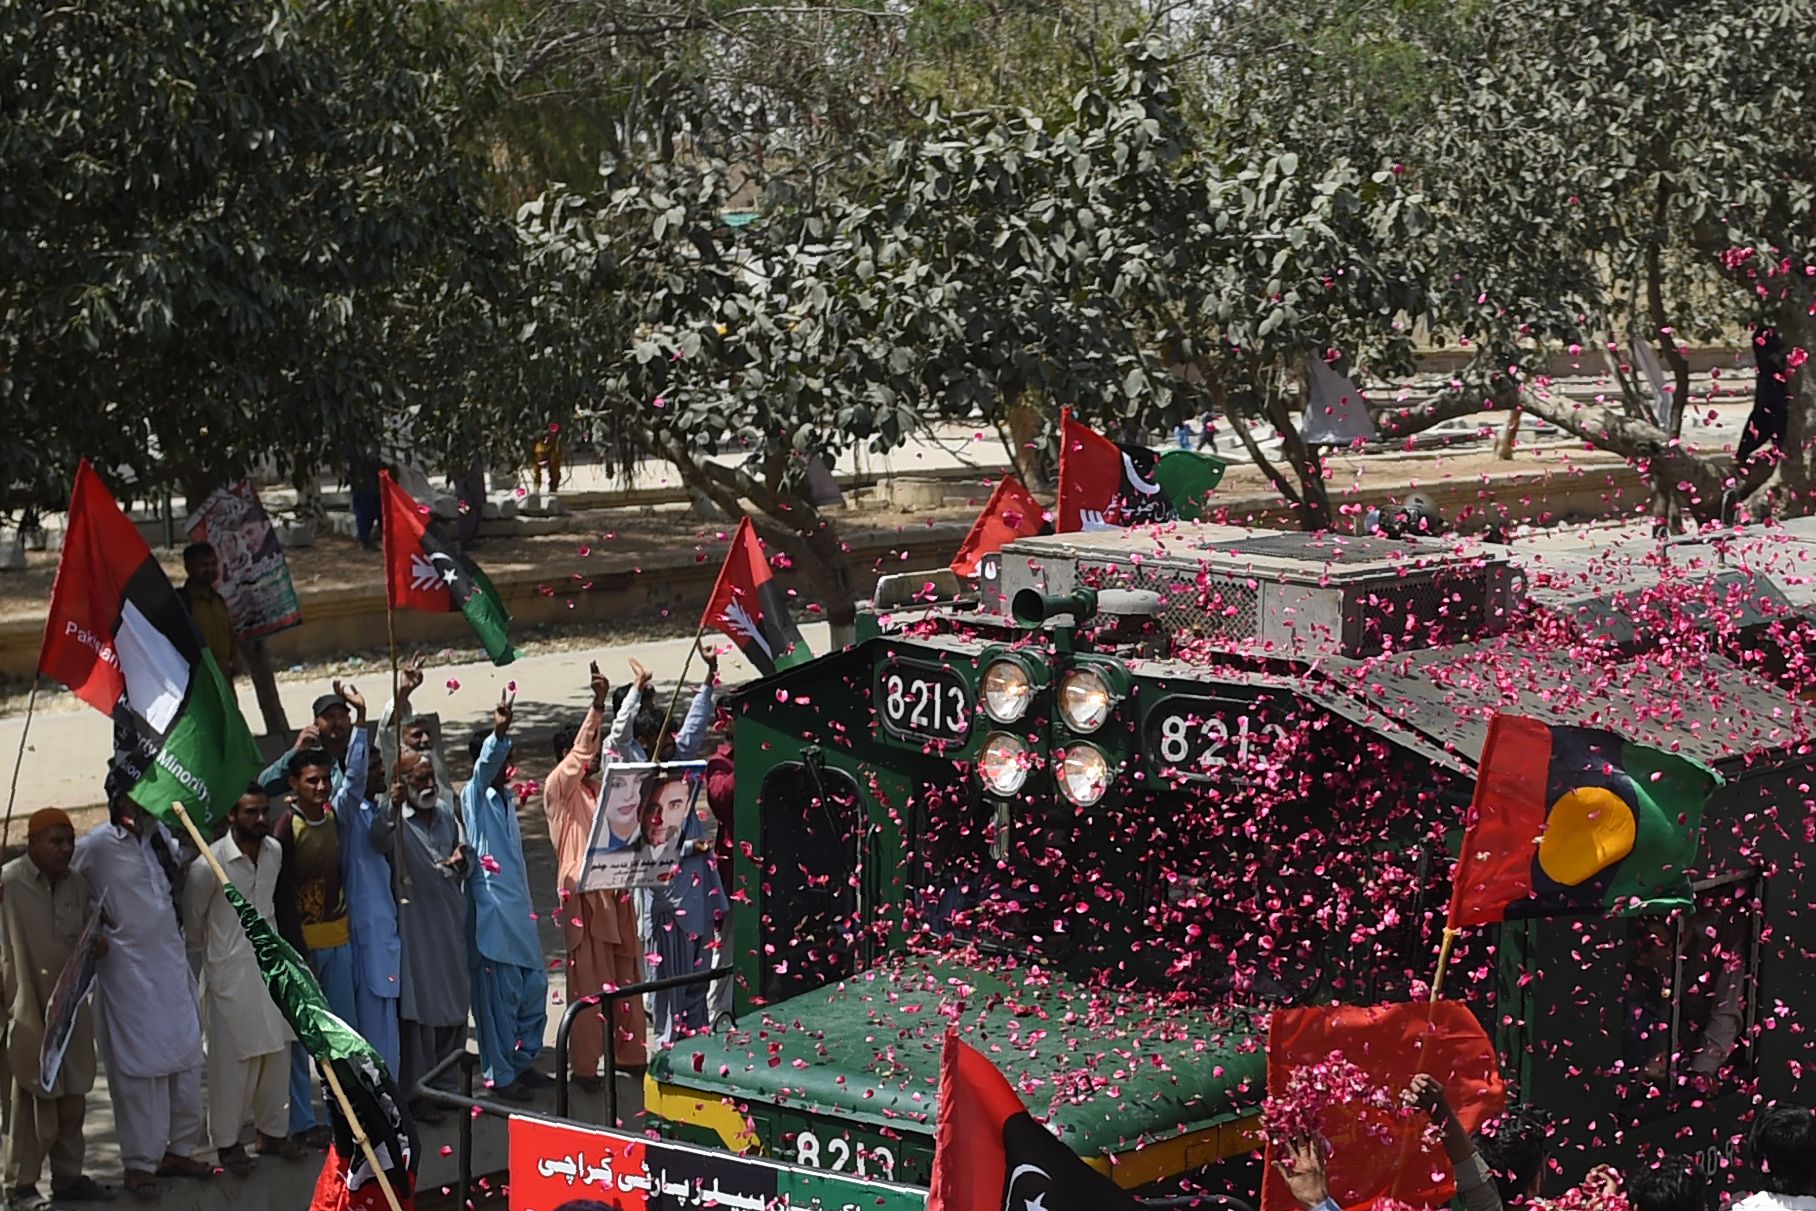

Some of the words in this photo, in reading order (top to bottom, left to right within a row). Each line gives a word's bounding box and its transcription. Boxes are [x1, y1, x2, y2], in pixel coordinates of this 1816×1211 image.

[887, 673, 966, 732] 8213
[156, 748, 210, 801] Minority
[537, 1150, 614, 1186] کراچی
[617, 1160, 690, 1208] پارٹی
